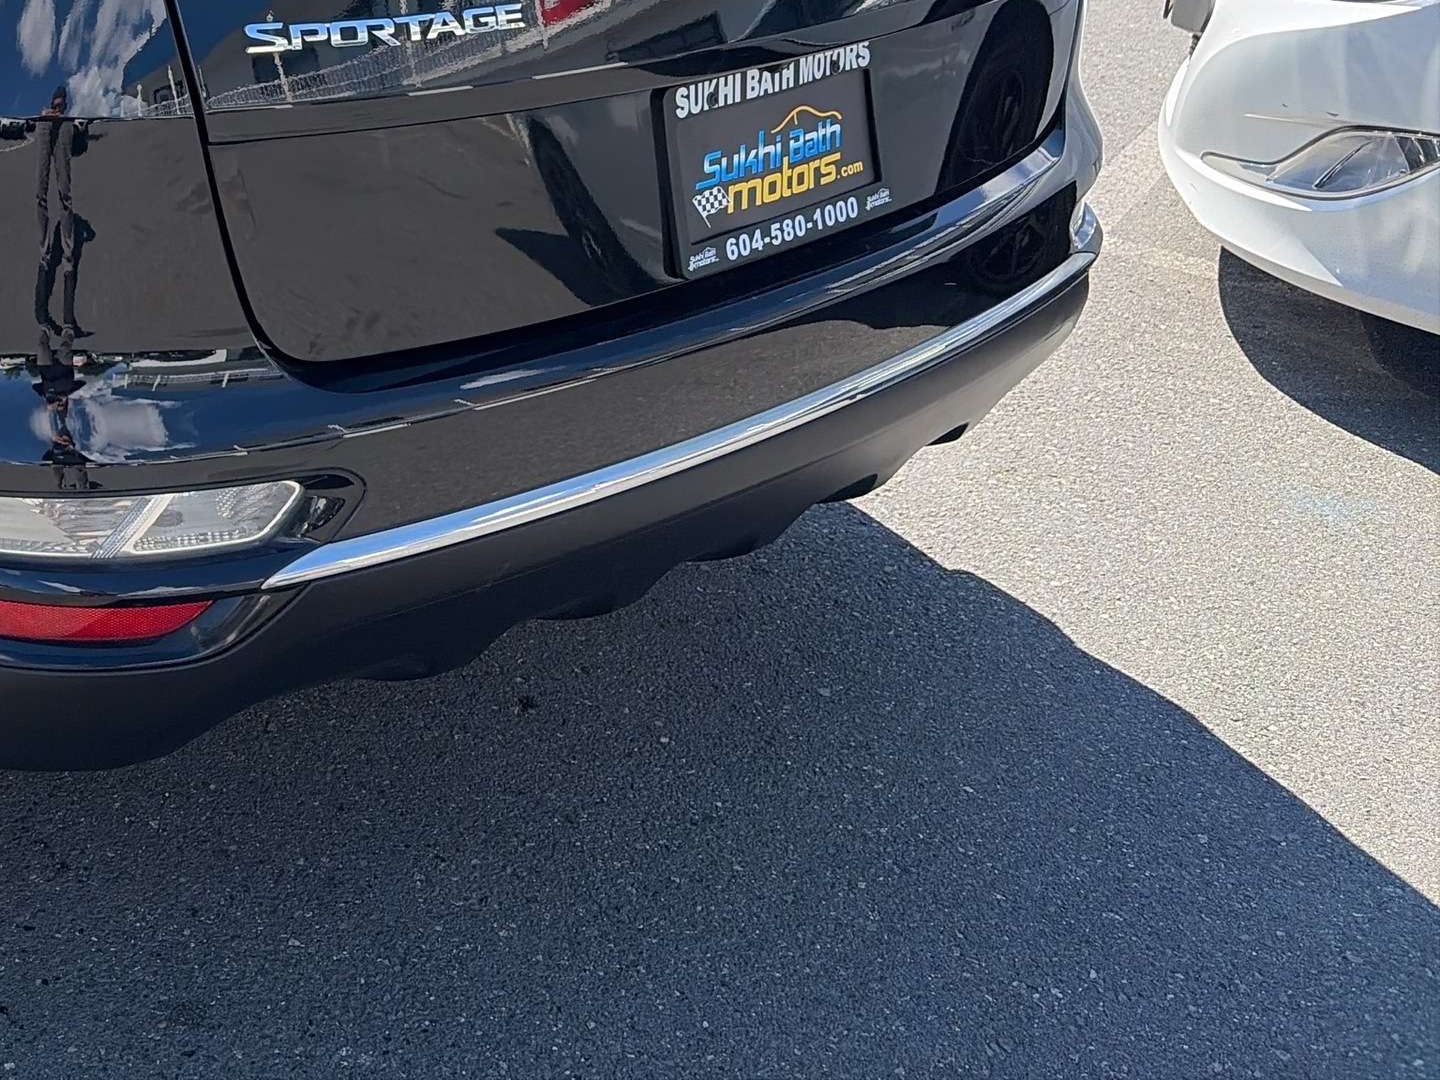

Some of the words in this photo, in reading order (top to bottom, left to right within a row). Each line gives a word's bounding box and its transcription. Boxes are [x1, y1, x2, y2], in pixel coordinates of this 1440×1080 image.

[244, 2, 526, 55] SPORTAGE
[675, 73, 741, 119] SUKHI
[696, 128, 782, 190] Sukhi
[789, 118, 842, 164] Bath
[725, 195, 859, 261] 604-580-1000
